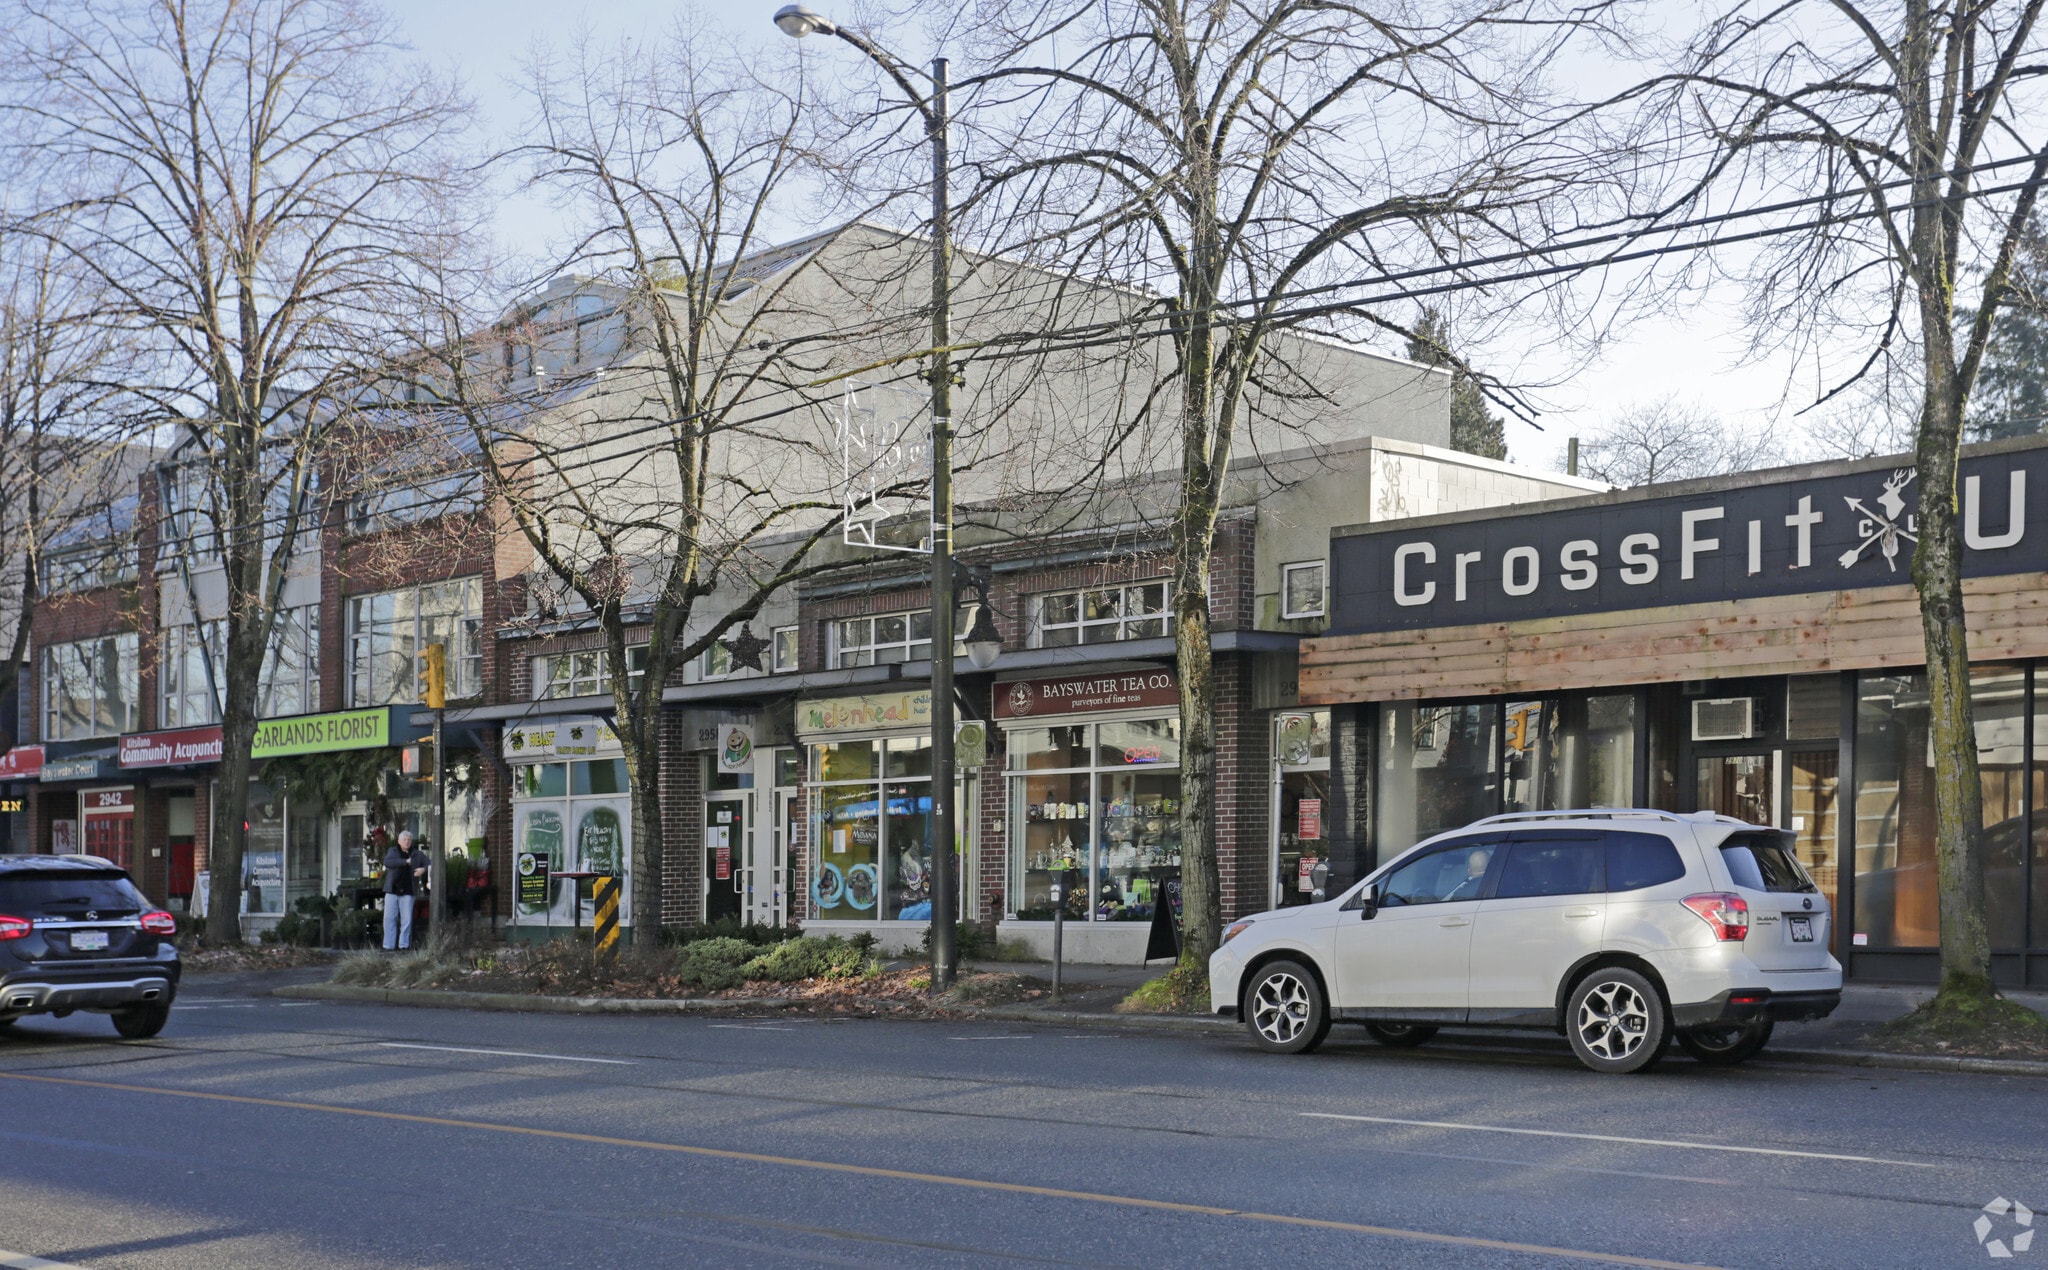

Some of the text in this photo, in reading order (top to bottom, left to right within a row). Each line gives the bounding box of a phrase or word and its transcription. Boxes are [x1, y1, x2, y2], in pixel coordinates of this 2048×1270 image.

[1394, 495, 1823, 606] CrossFit
[1043, 674, 1172, 698] BAYSWATER TEA CO.
[1072, 693, 1141, 708] purveyors of fine teas
[252, 715, 379, 749] GARLANDS FLORIST
[529, 731, 555, 747] HEALT
[121, 739, 223, 763] Community Acupunctu
[127, 737, 151, 748] Kitsilano
[1124, 745, 1161, 763] OPEN
[75, 763, 94, 775] Court
[99, 792, 122, 806] 2942
